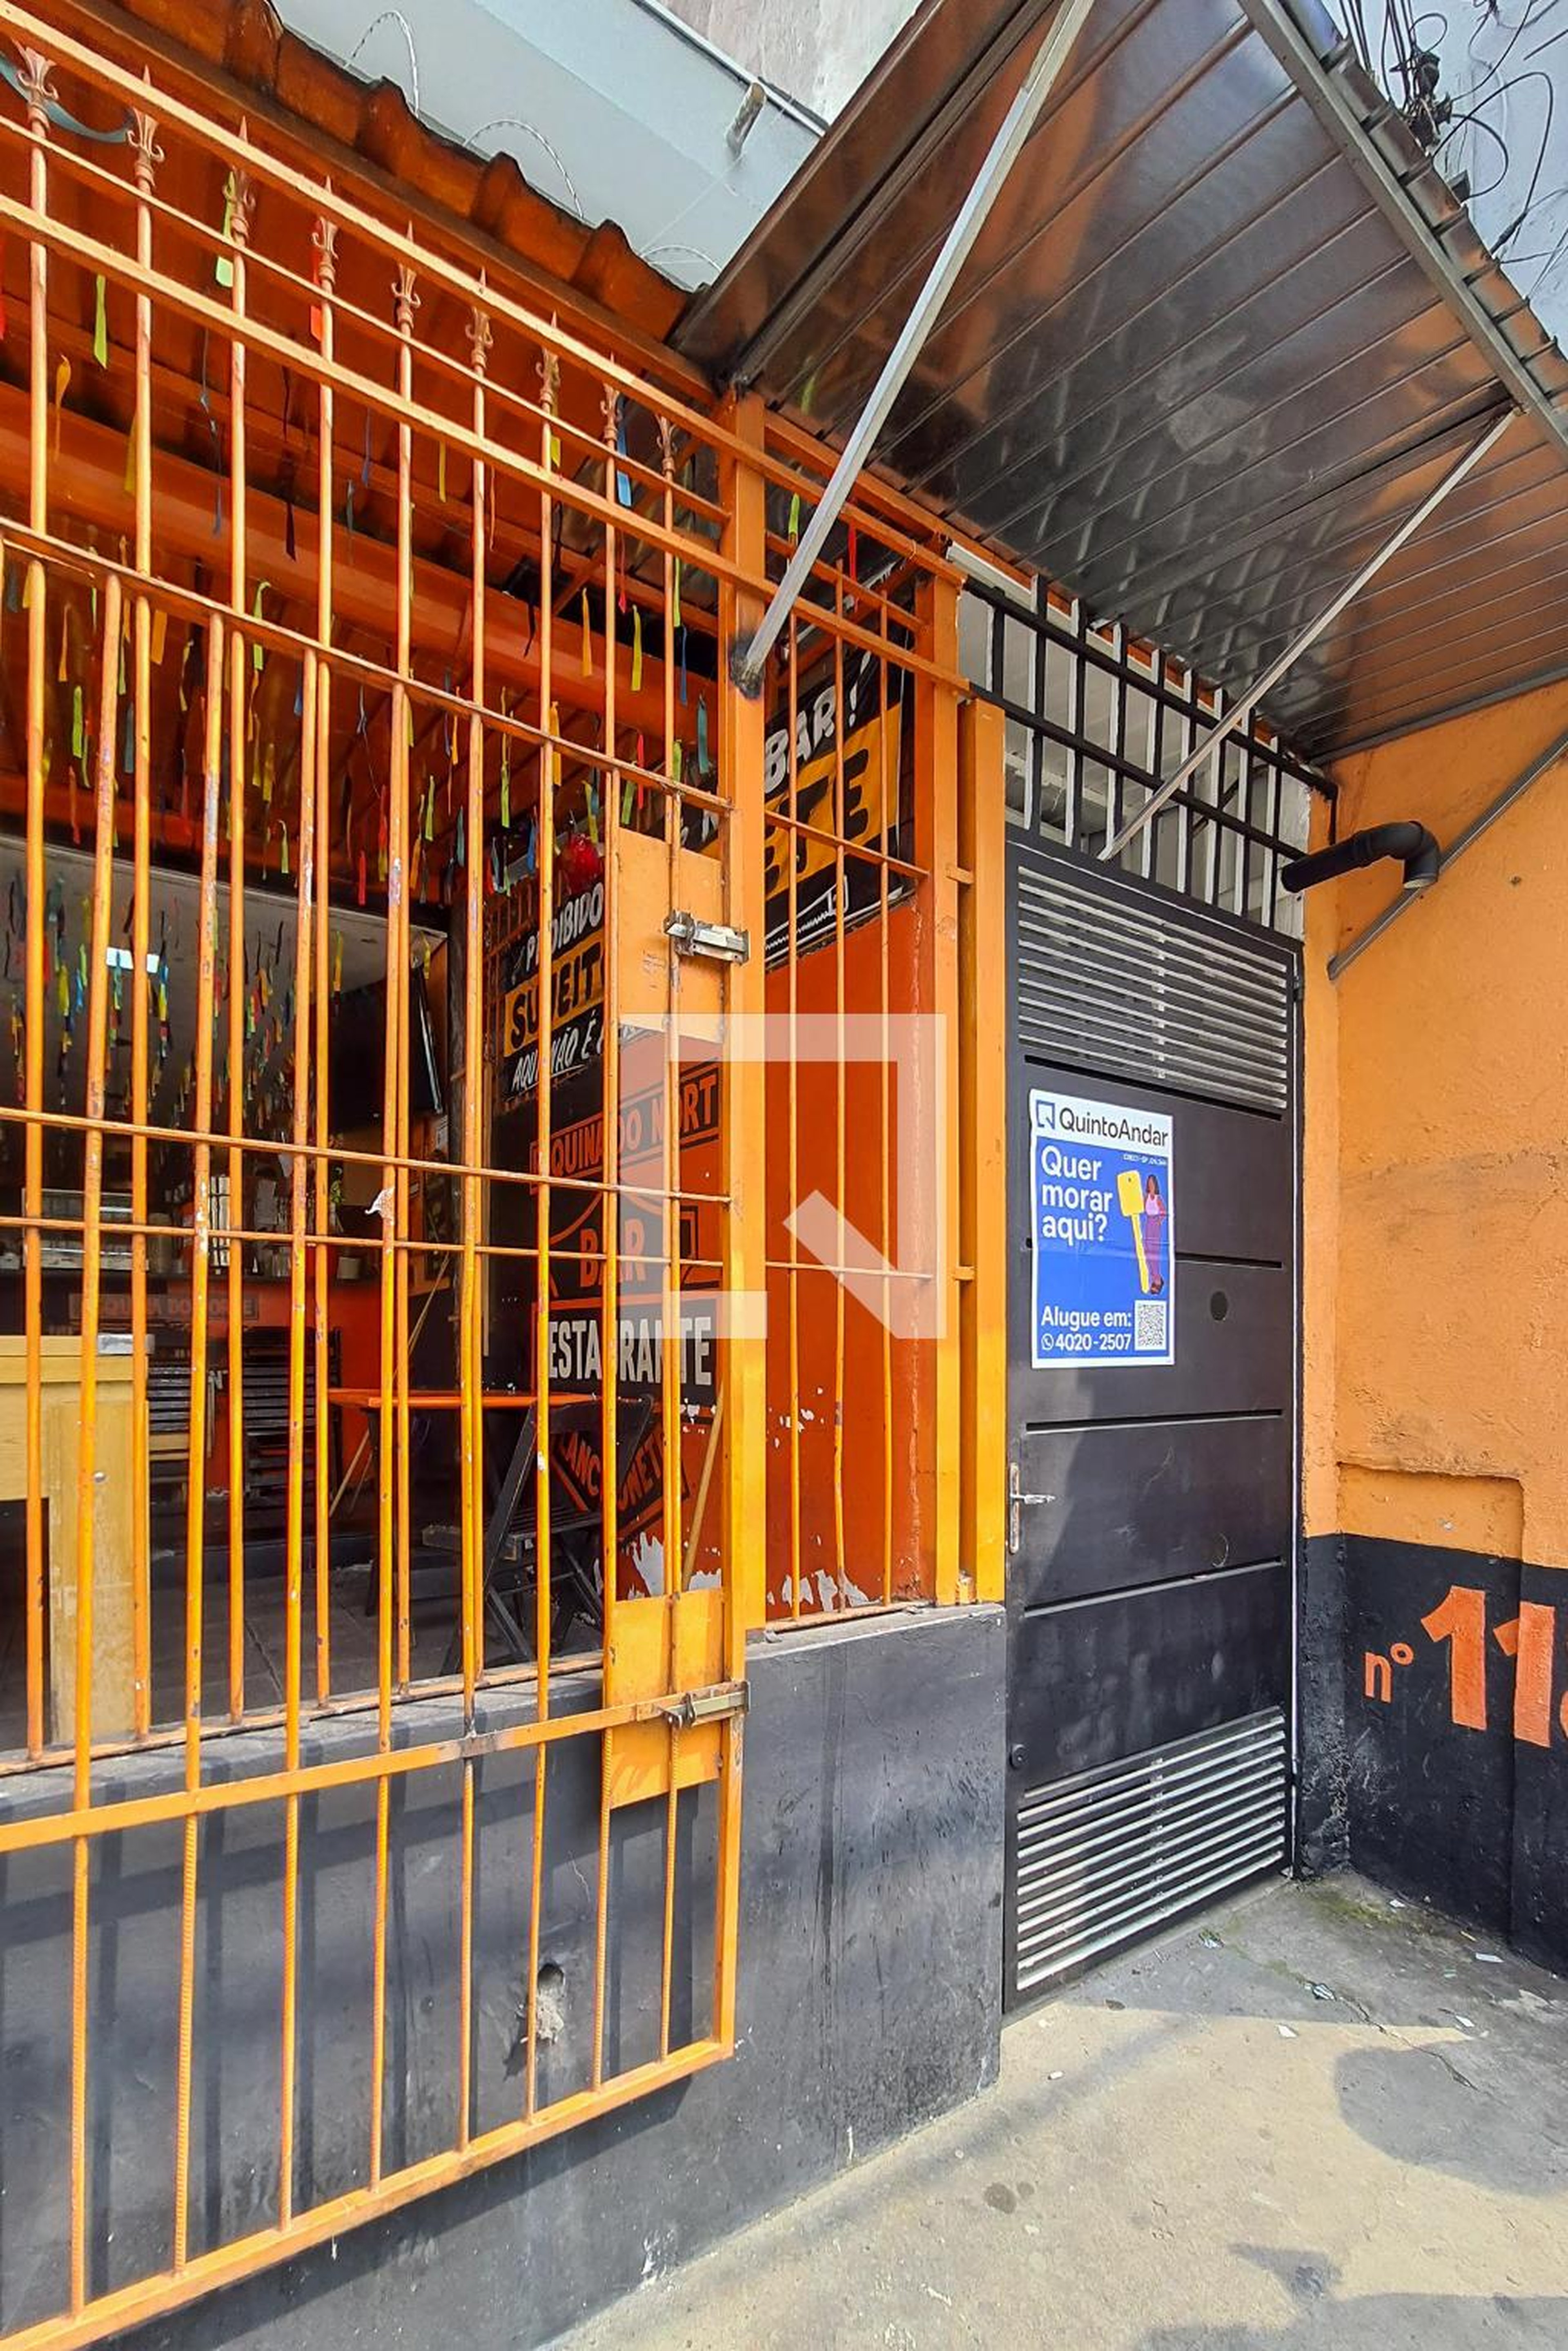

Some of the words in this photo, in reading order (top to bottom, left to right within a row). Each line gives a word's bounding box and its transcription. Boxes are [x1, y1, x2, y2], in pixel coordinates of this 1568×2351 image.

[526, 882, 604, 972] POIBIDO
[1059, 1107, 1168, 1147] QuintoAndar
[1041, 1145, 1102, 1181] Quer
[1042, 1184, 1113, 1212] morar
[1042, 1213, 1107, 1246] aqui?
[580, 1218, 646, 1287] BR
[1041, 1305, 1100, 1331] Alugue
[1104, 1312, 1131, 1327] em:
[549, 1316, 712, 1385] ESTARATE
[1420, 1585, 1568, 1748] 11
